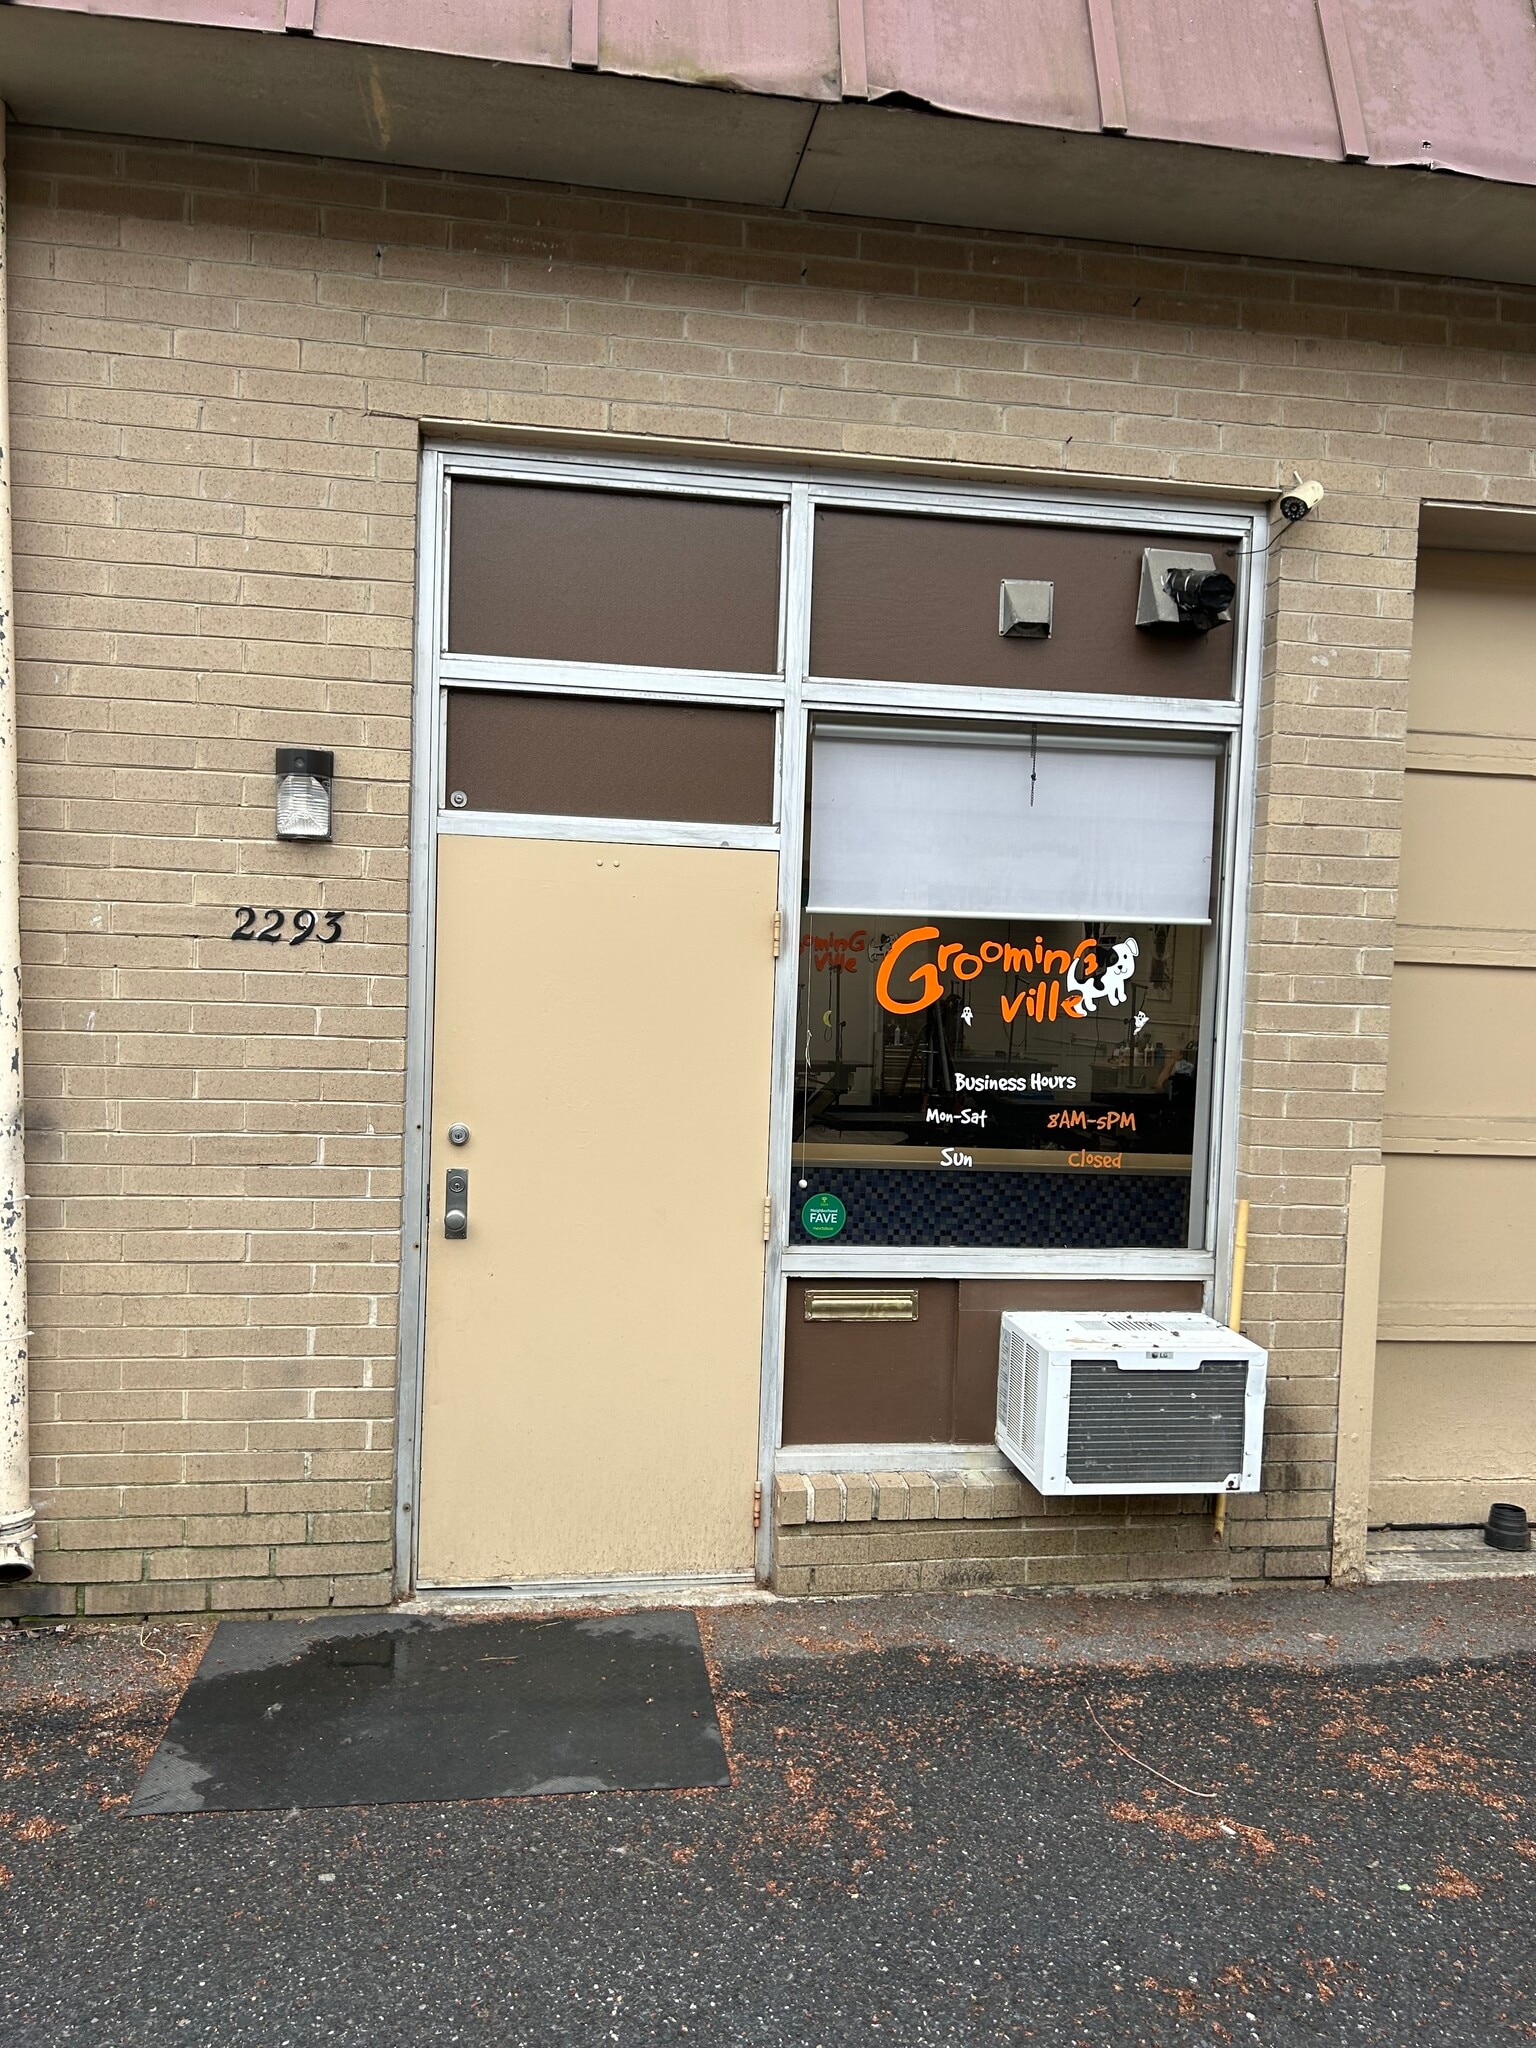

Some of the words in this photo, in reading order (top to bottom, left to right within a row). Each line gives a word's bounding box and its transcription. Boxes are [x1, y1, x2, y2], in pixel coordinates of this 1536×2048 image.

[231, 906, 345, 945] 2293
[954, 1072, 1026, 1092] Business
[1030, 1072, 1077, 1091] Hours
[925, 1108, 988, 1128] Mon-Sat
[1047, 1109, 1136, 1131] 8AM-5PM
[939, 1147, 973, 1167] Sun
[1067, 1149, 1123, 1168] Closed
[810, 1212, 838, 1224] FAVE
